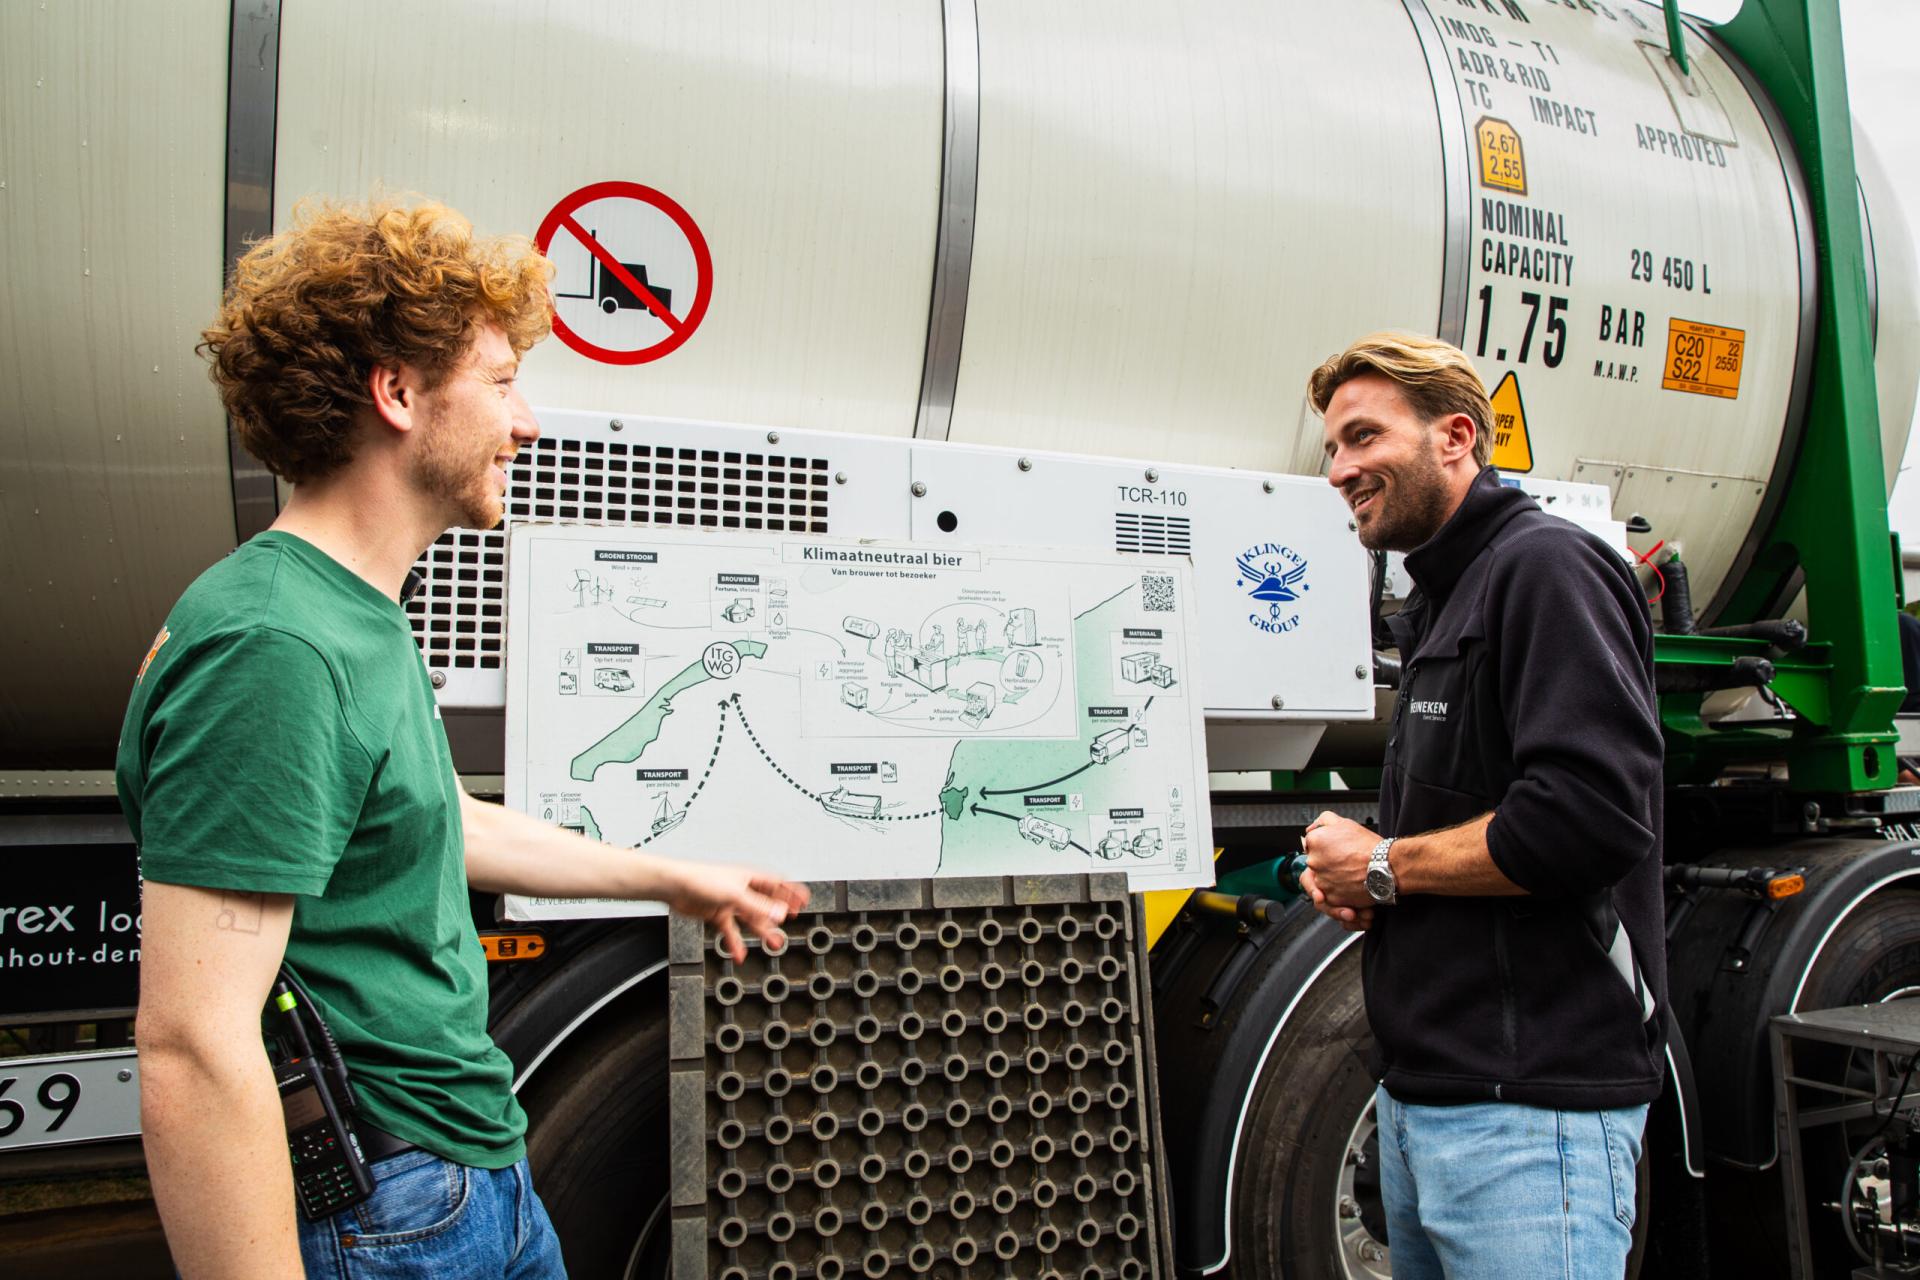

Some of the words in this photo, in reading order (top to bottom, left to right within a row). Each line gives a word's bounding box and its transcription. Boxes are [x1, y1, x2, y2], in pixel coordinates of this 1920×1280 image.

[1440, 15, 1498, 49] IMDG
[1531, 41, 1560, 65] T1
[1464, 79, 1493, 110] TC
[1529, 96, 1599, 137] IMPACT
[1635, 123, 1727, 168] APPROVED
[1490, 155, 1521, 180] 2,55
[1481, 198, 1568, 246] NOMINAL
[1481, 238, 1574, 287] CAPACITY
[1631, 249, 1652, 282] 29
[1662, 256, 1694, 292] 450
[1703, 263, 1712, 294] L
[1476, 285, 1569, 368] 1.75
[1599, 304, 1645, 348] BAR
[1675, 333, 1704, 359] C20
[1728, 343, 1740, 357] 22
[1593, 359, 1639, 383] M.A.W.P.
[1672, 357, 1702, 381] S22
[1715, 356, 1738, 372] 2550
[1495, 432, 1511, 447] AVY
[1118, 486, 1187, 507] TCR-110
[600, 552, 625, 560] GROENE
[626, 553, 653, 561] STROOM
[803, 547, 928, 565] Klimaatneutraal
[933, 553, 963, 566] bier
[1243, 543, 1302, 566] KLINGE
[831, 568, 847, 576] Van
[850, 569, 884, 577] brouwer
[899, 571, 937, 579] bezoeker
[1249, 614, 1299, 634] GROUP
[711, 647, 733, 662] ITG
[708, 660, 733, 675] WO
[1093, 708, 1124, 716] TRANSPORT
[0, 905, 75, 935] rex
[0, 943, 141, 968] hout-den
